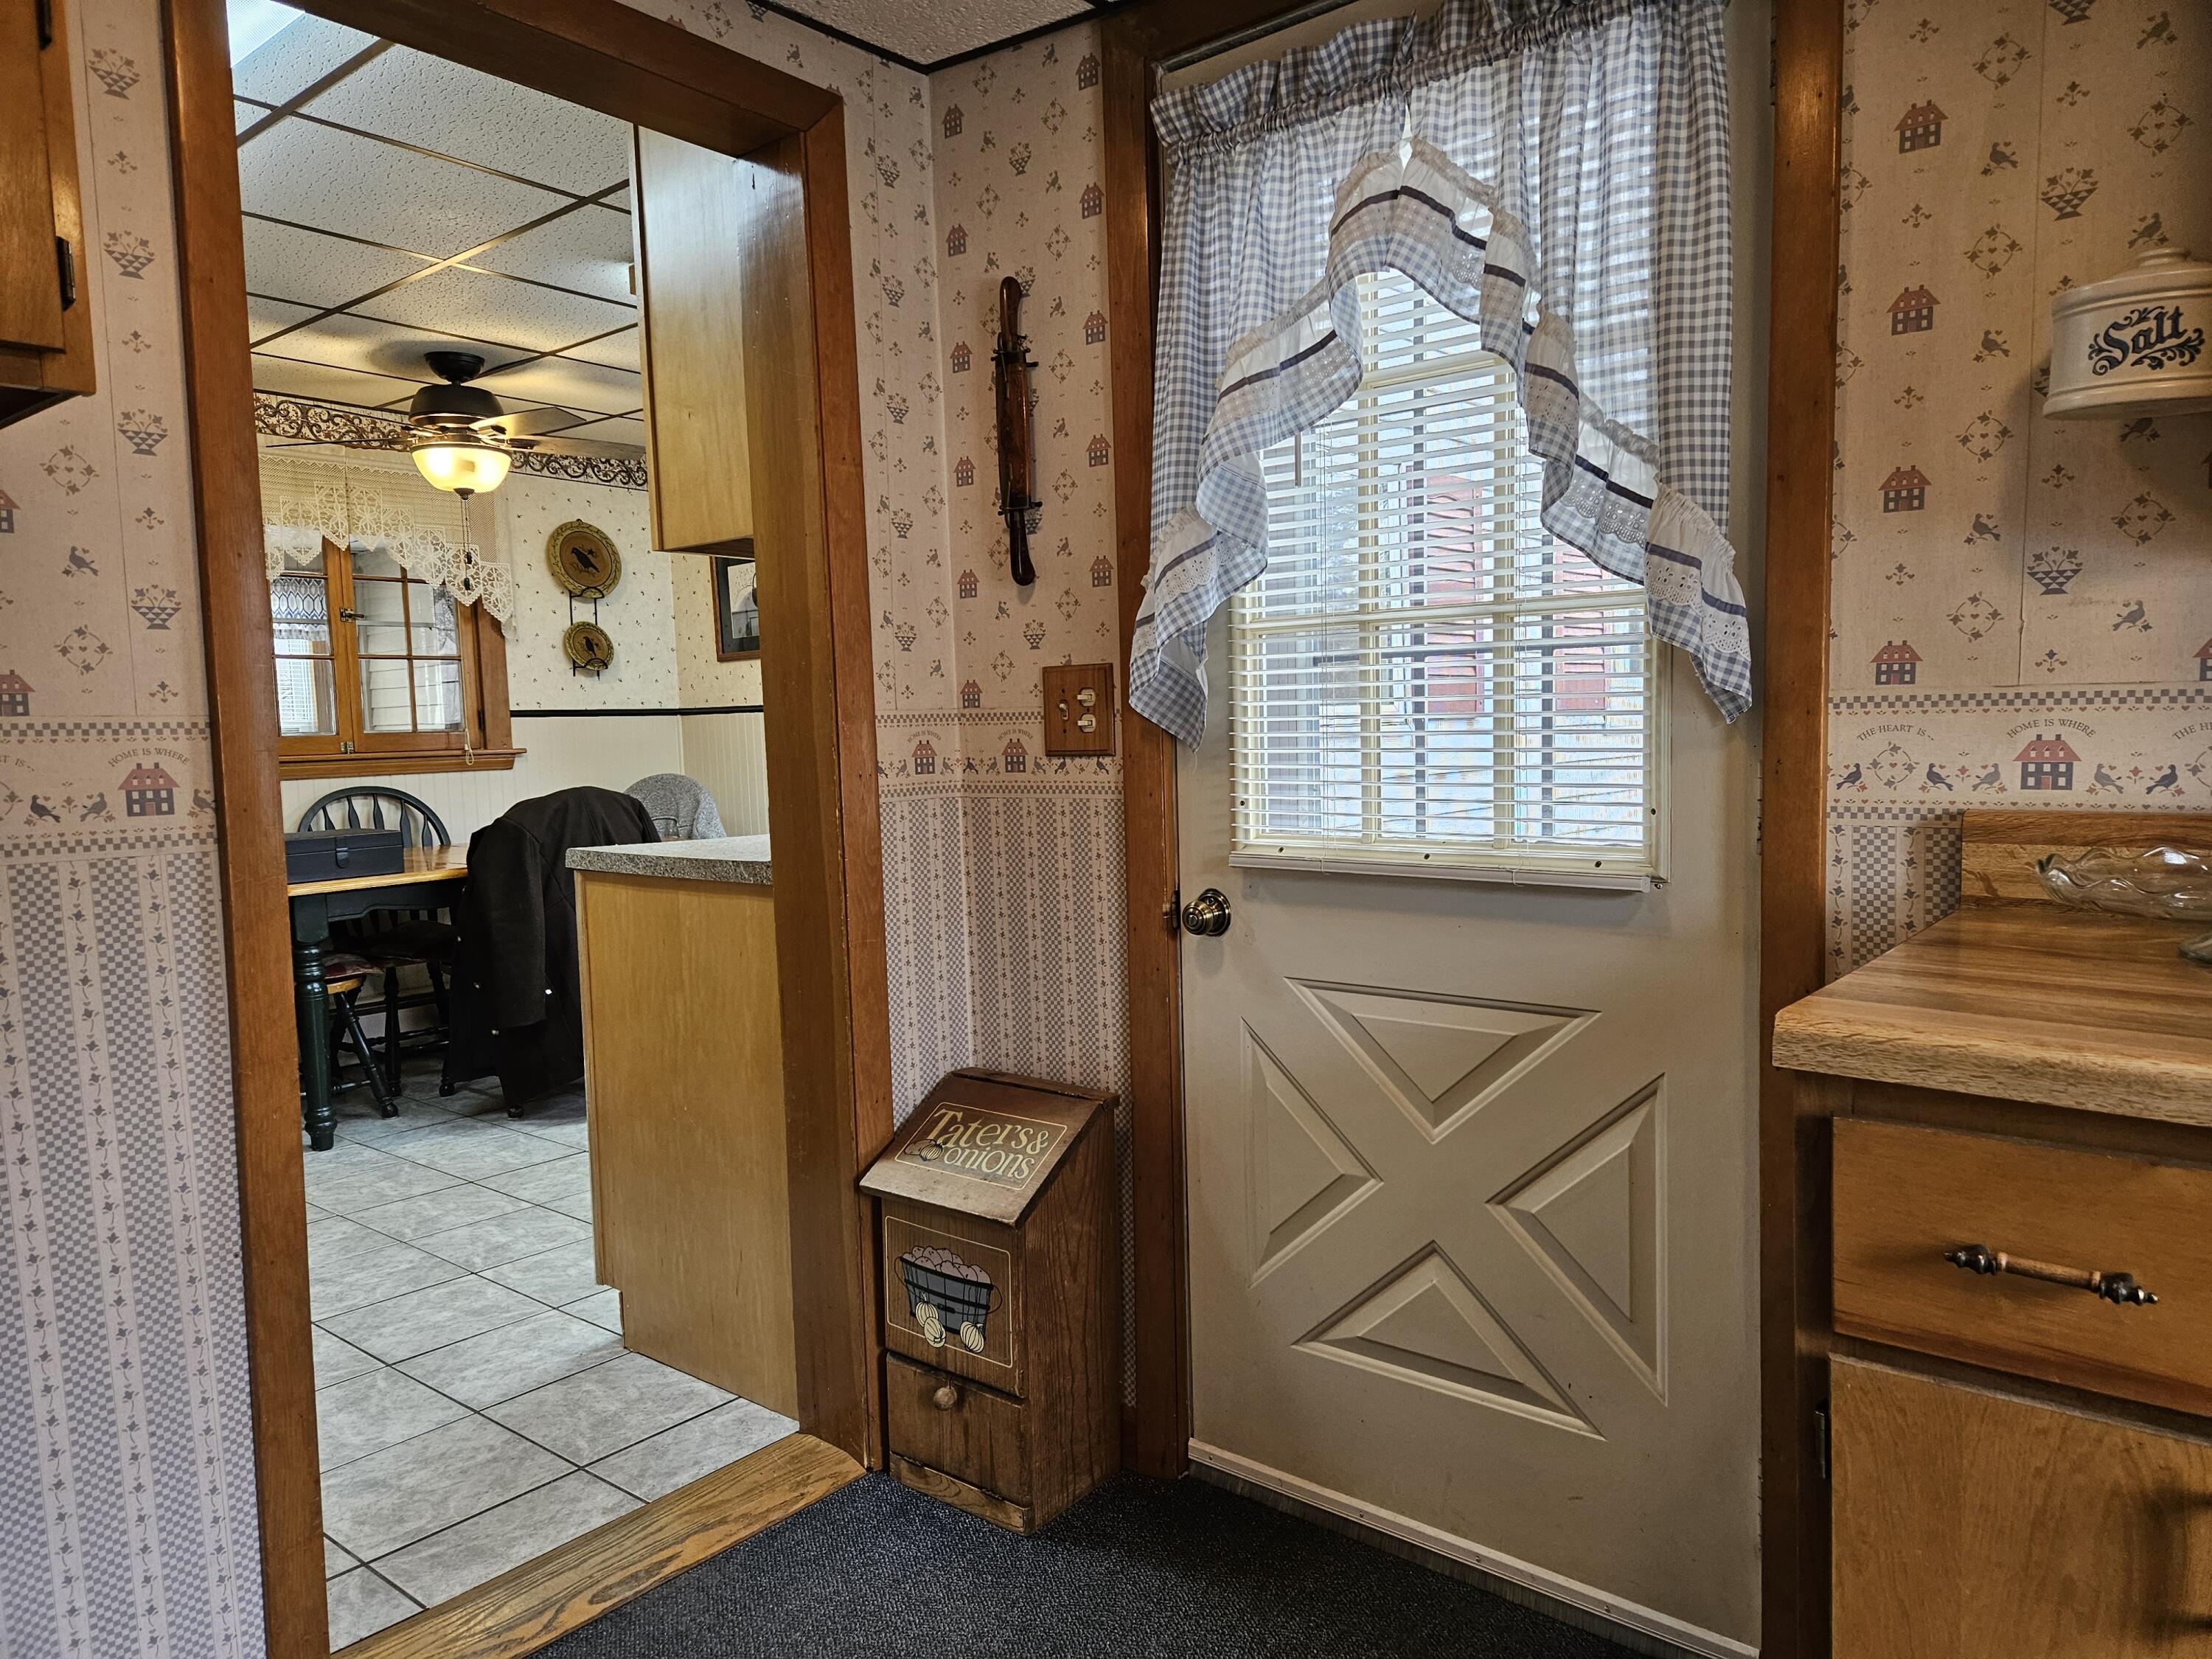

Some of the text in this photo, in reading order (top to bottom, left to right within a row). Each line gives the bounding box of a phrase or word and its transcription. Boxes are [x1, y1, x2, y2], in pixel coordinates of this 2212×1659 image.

[2092, 305, 2188, 376] Salt
[1857, 727, 1877, 741] THE
[1878, 724, 1914, 733] HEART
[2006, 718, 2096, 738] HOME IS WHERE
[2171, 724, 2197, 740] THE
[108, 748, 190, 768] HOME IS WHERE
[925, 1108, 1034, 1149] Taters
[944, 1146, 1035, 1180] onions
